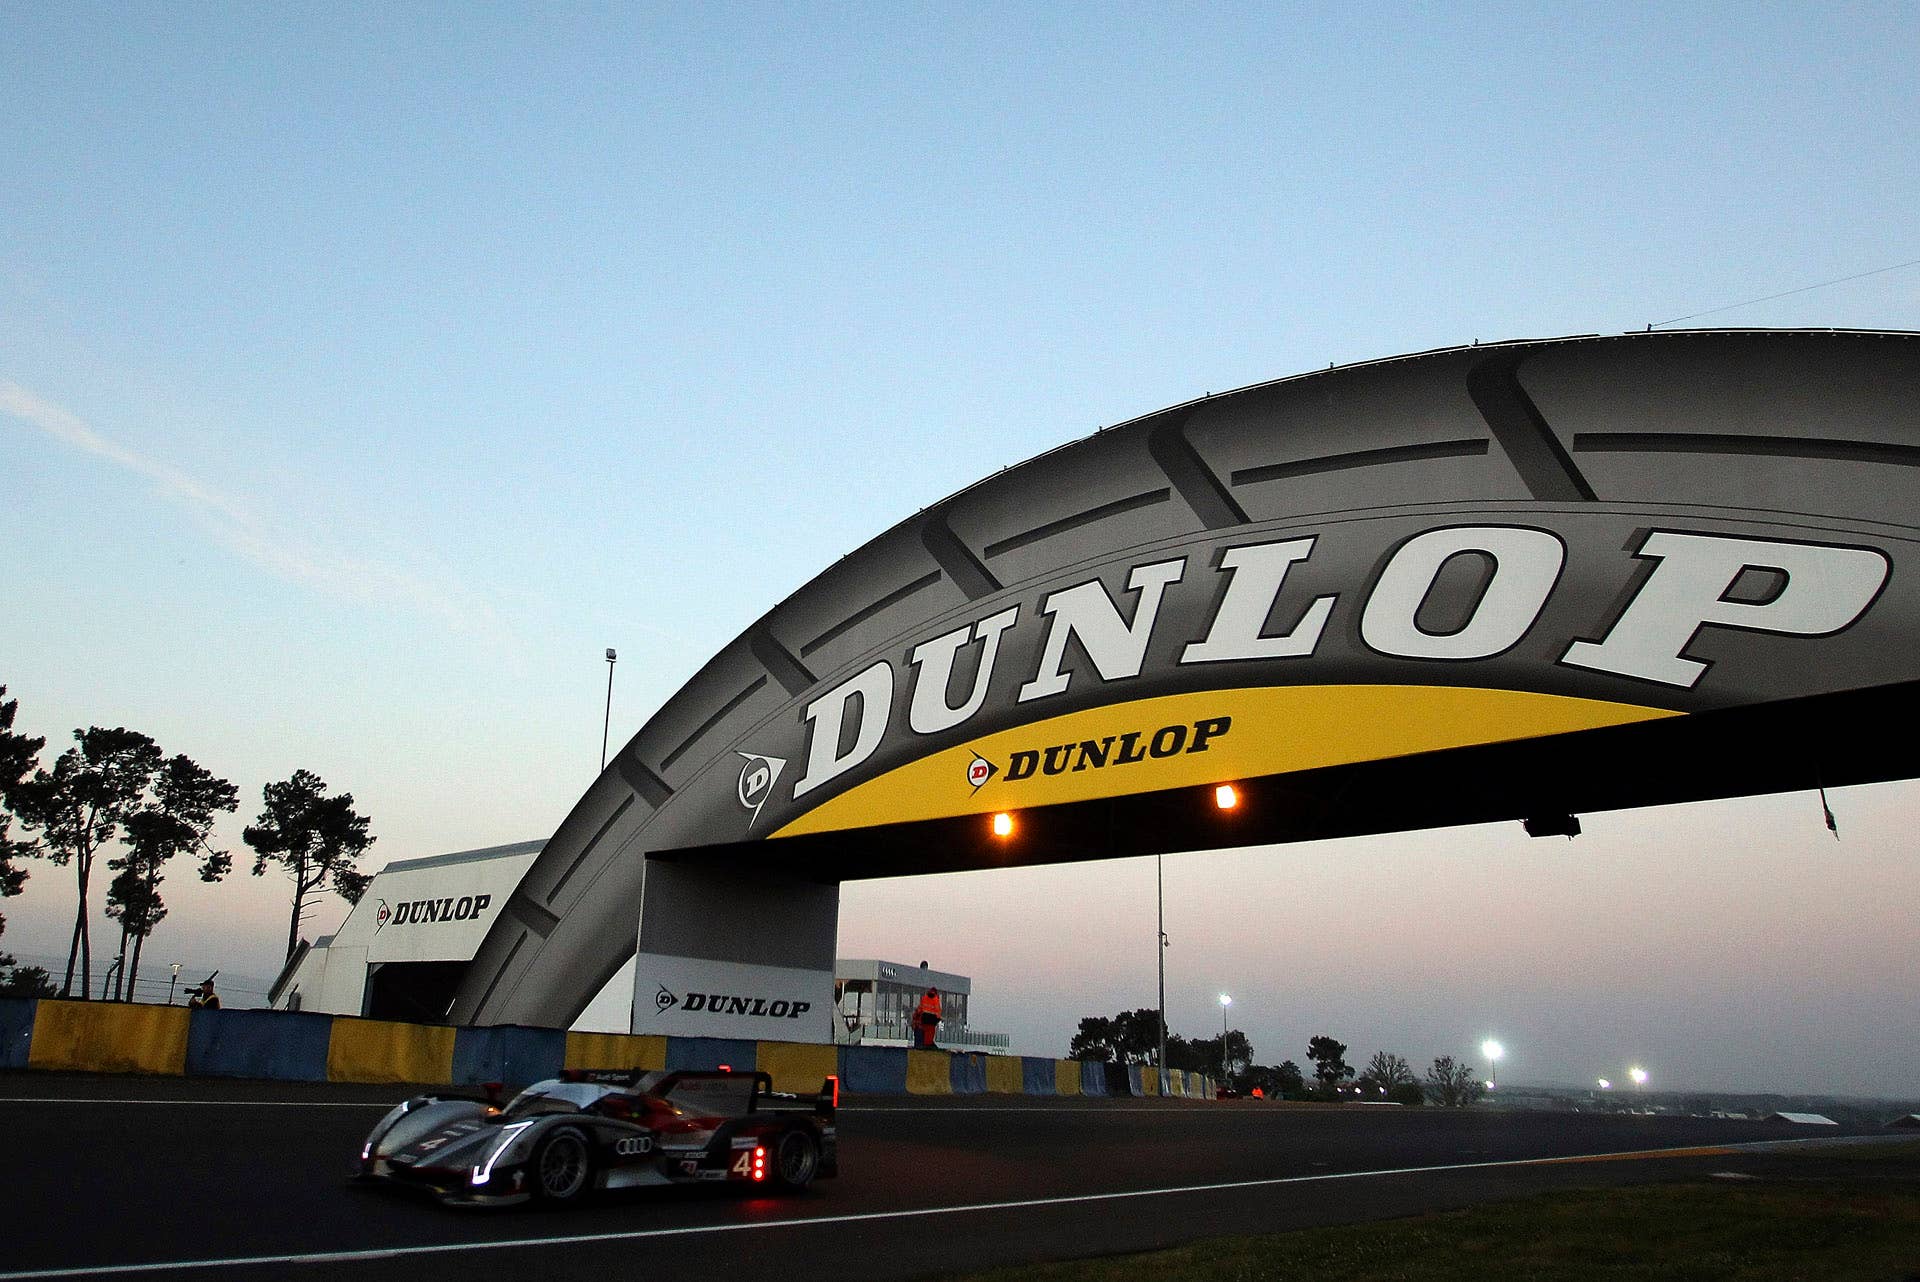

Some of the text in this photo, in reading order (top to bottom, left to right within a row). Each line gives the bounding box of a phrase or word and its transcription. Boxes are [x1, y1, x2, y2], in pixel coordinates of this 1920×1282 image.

[793, 526, 1889, 798] DUNLOP
[1002, 716, 1232, 782] DUNLOP
[391, 894, 492, 926] DUNLOP
[681, 992, 811, 1019] DUNLOP
[731, 1151, 752, 1177] 4
